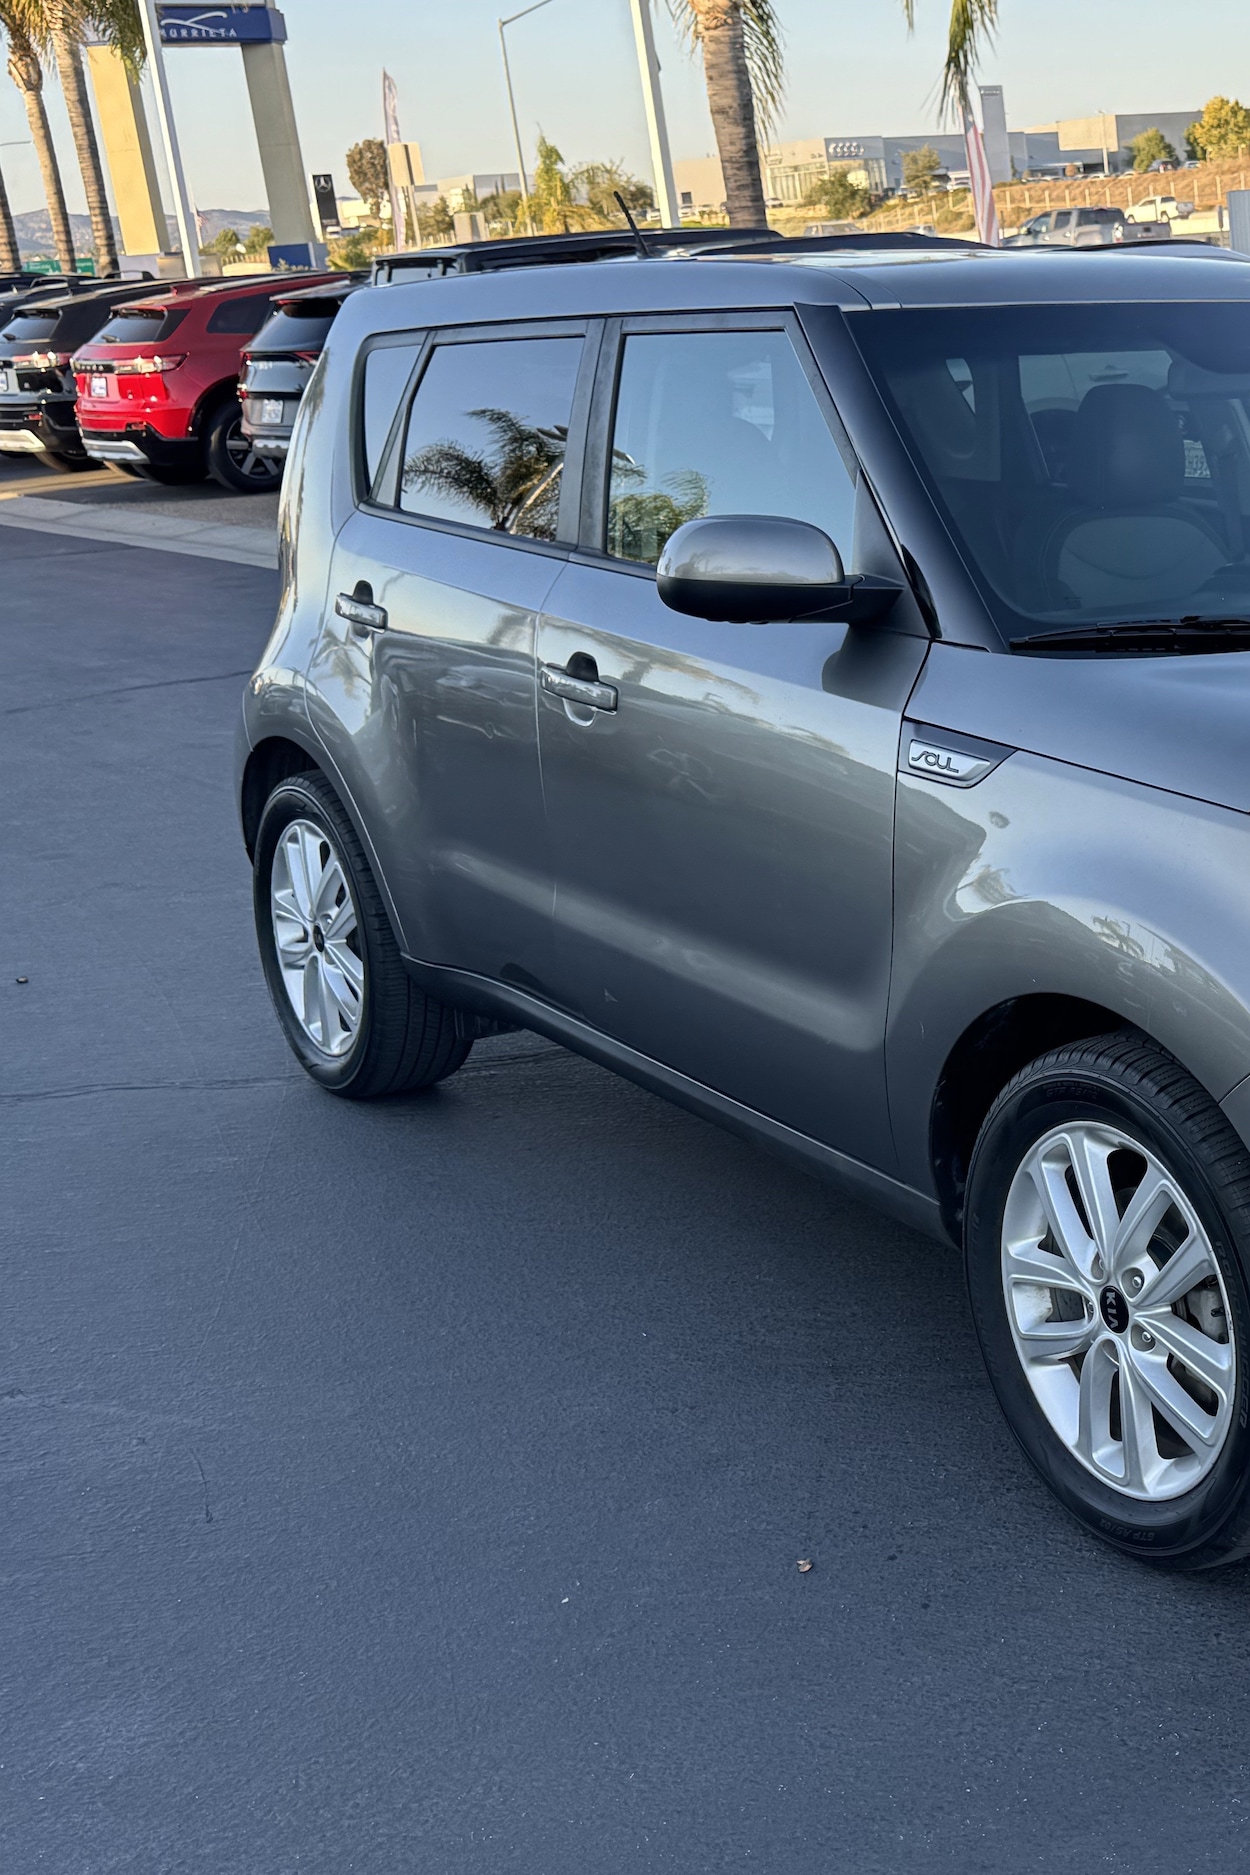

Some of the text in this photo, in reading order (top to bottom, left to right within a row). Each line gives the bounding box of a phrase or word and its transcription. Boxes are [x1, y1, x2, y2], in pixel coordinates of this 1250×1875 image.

[911, 751, 959, 773] SOUL
[1106, 1291, 1119, 1329] KIA
[1236, 1318, 1250, 1429] HUGGER
